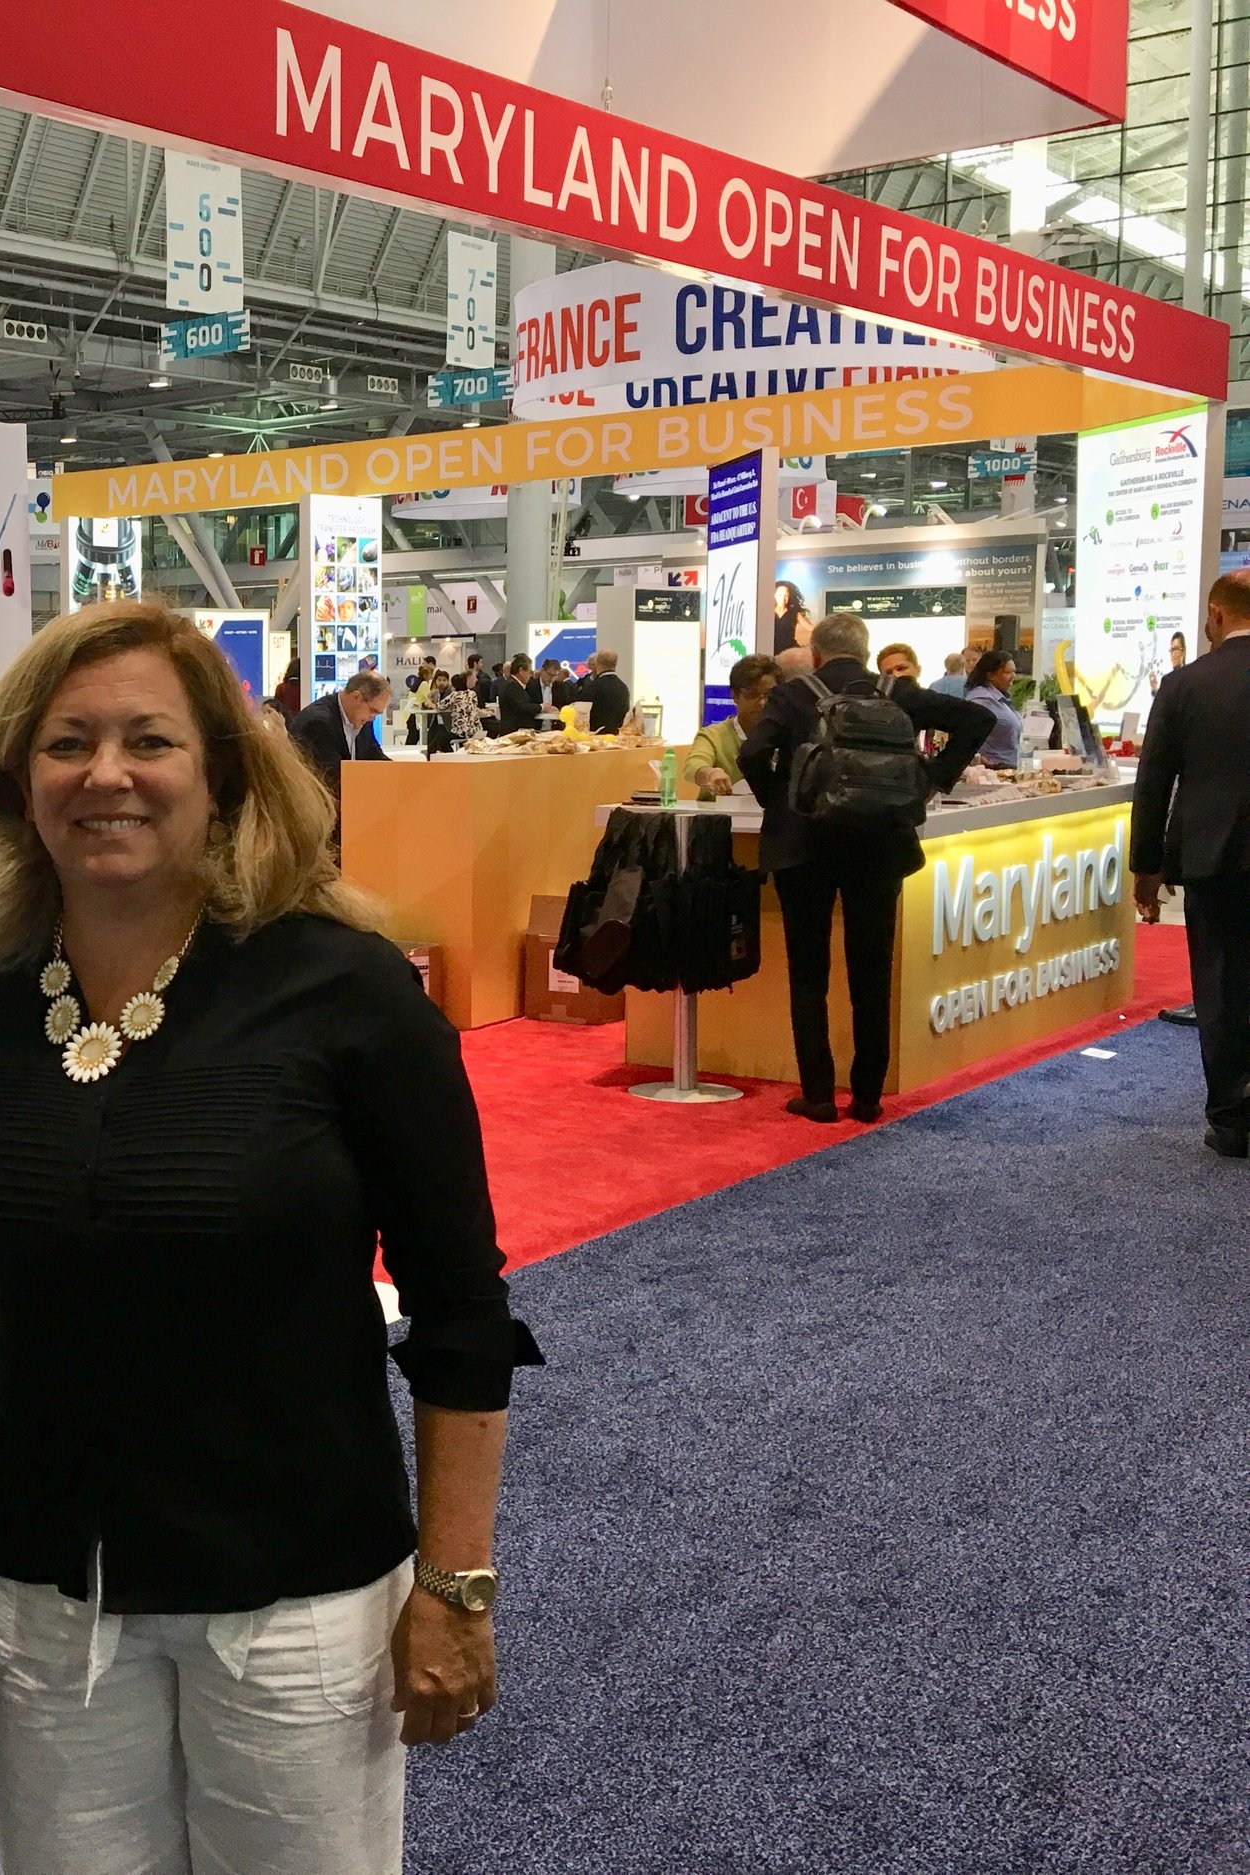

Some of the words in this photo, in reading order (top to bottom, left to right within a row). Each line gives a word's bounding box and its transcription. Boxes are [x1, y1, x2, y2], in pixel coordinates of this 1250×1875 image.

[276, 27, 697, 243] MARYLAND
[719, 177, 860, 290] OPEN
[879, 224, 961, 318] FOR
[975, 256, 1136, 364] BUSINESS
[186, 323, 223, 349] 600
[453, 376, 488, 397] 700
[109, 452, 350, 509] MARYLAND
[366, 435, 502, 485] OPEN
[527, 422, 633, 471] FOR
[658, 384, 974, 459] BUSINESS
[984, 458, 1021, 472] 1000
[828, 564, 844, 573] She
[846, 561, 884, 572] believes
[886, 562, 895, 570] in
[965, 567, 995, 577] about
[997, 566, 1032, 577] yours?
[933, 819, 1124, 955] Maryland
[930, 980, 988, 1034] OPEN
[991, 966, 1033, 1012] FOR
[1036, 938, 1120, 997] BUSINESS
